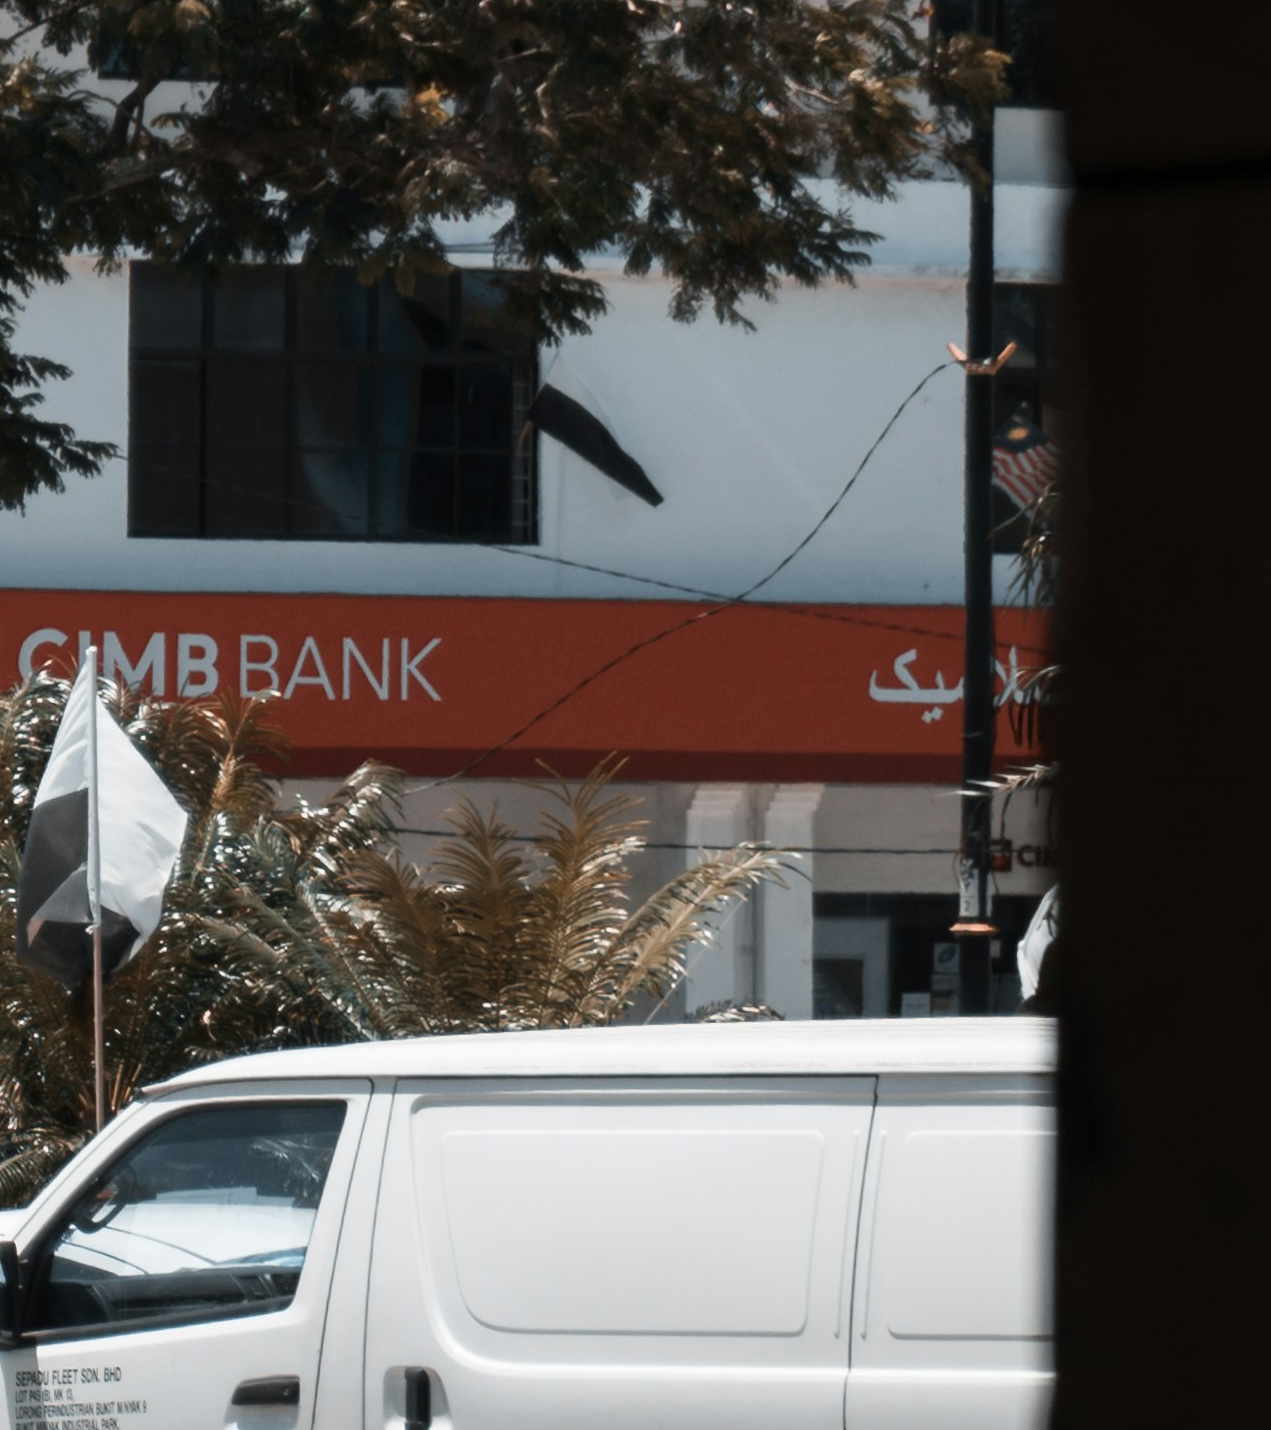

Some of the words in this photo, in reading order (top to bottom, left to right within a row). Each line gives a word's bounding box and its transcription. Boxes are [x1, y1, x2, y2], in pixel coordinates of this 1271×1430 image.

[239, 634, 442, 702] BANK
[15, 1370, 50, 1386] SEPADU
[52, 1369, 79, 1385] FLEET
[81, 1368, 101, 1384] SDN.
[103, 1366, 123, 1382] BHD
[15, 1389, 28, 1403] LOT
[15, 1405, 42, 1420] LORONG
[43, 1402, 95, 1418] PERINDUSTRIAN
[96, 1401, 116, 1415] BUKIT
